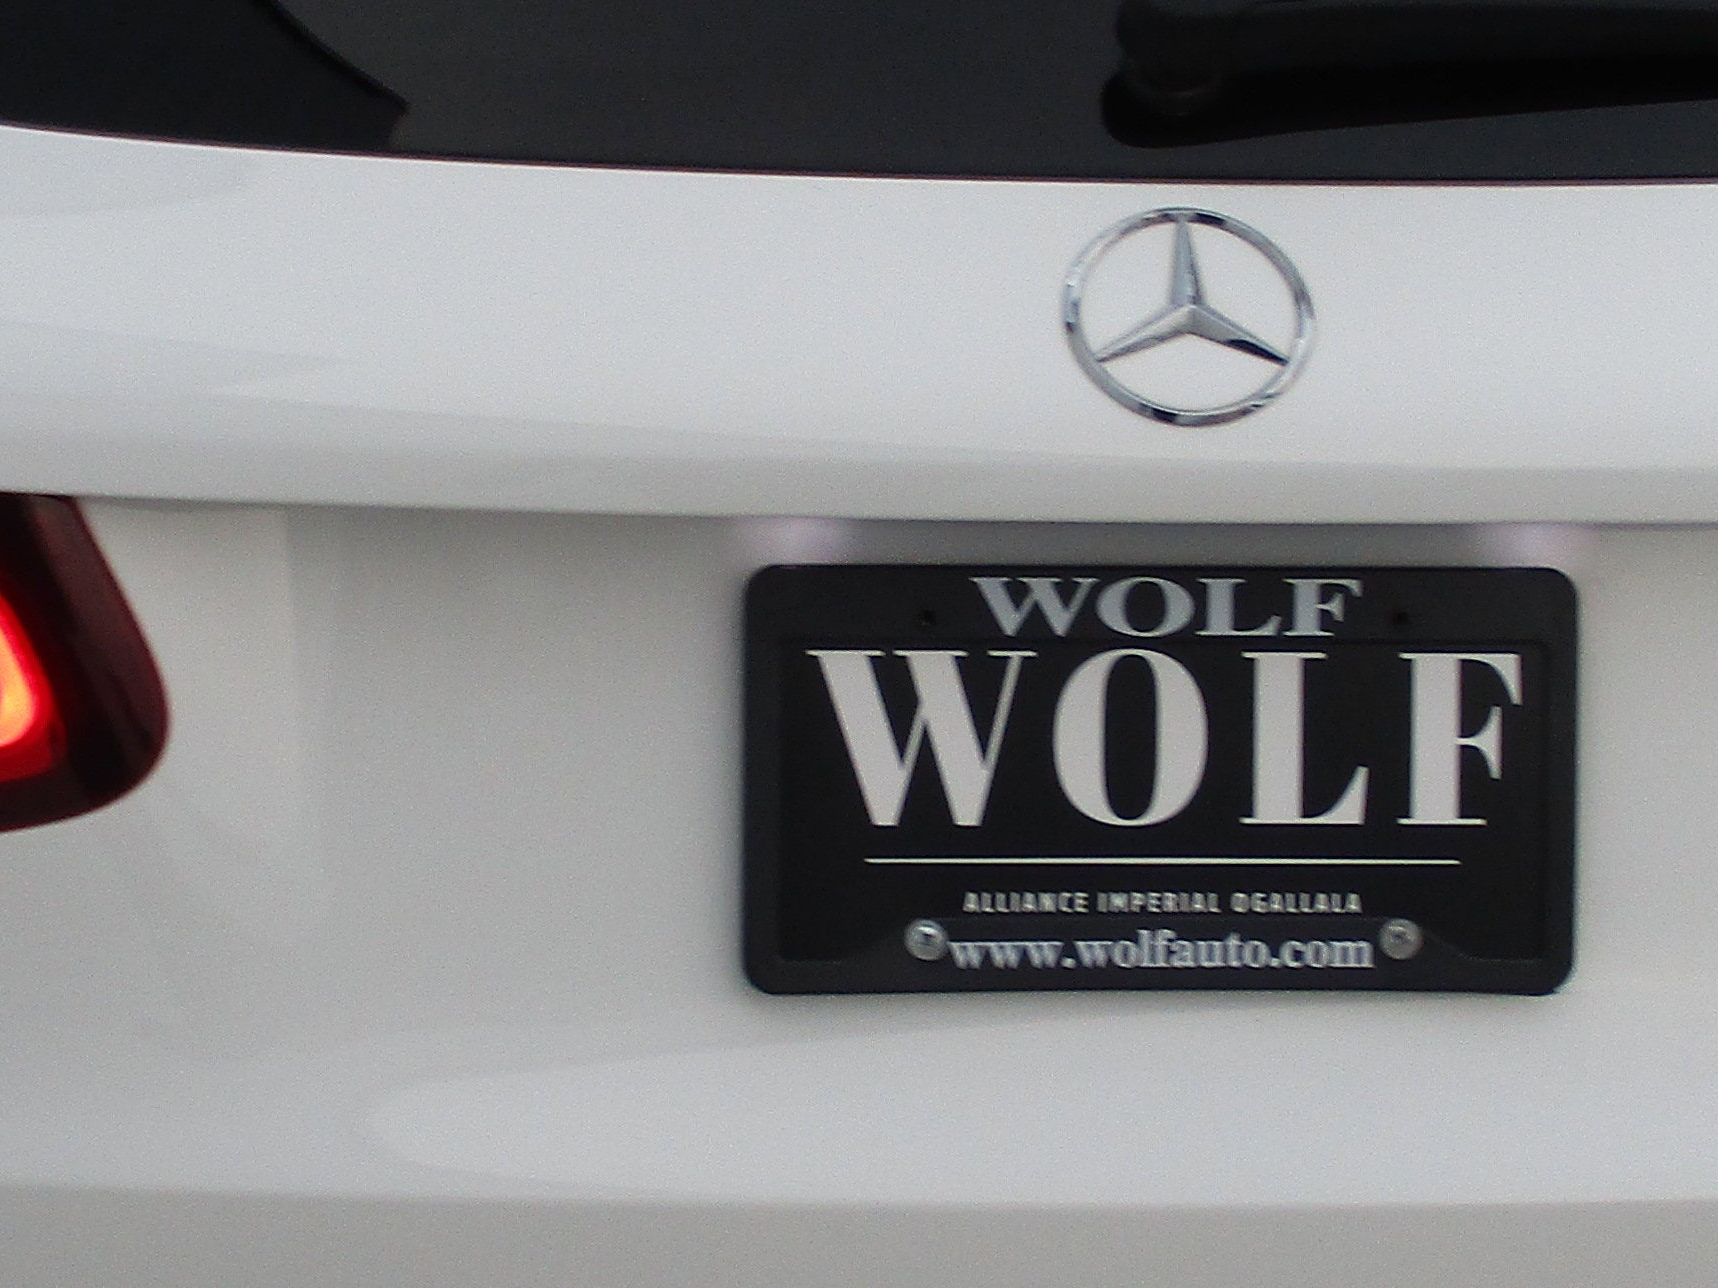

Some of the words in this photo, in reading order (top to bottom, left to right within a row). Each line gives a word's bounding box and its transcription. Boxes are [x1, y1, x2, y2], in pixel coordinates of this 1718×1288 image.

[970, 576, 1363, 637] WOLF
[805, 648, 1524, 827] WOLF
[962, 891, 1089, 913] ALLIANCE
[1096, 891, 1222, 913] IMPERIAL
[1230, 891, 1364, 913] OGALLALA
[947, 928, 1377, 970] www.wolfauto.com
